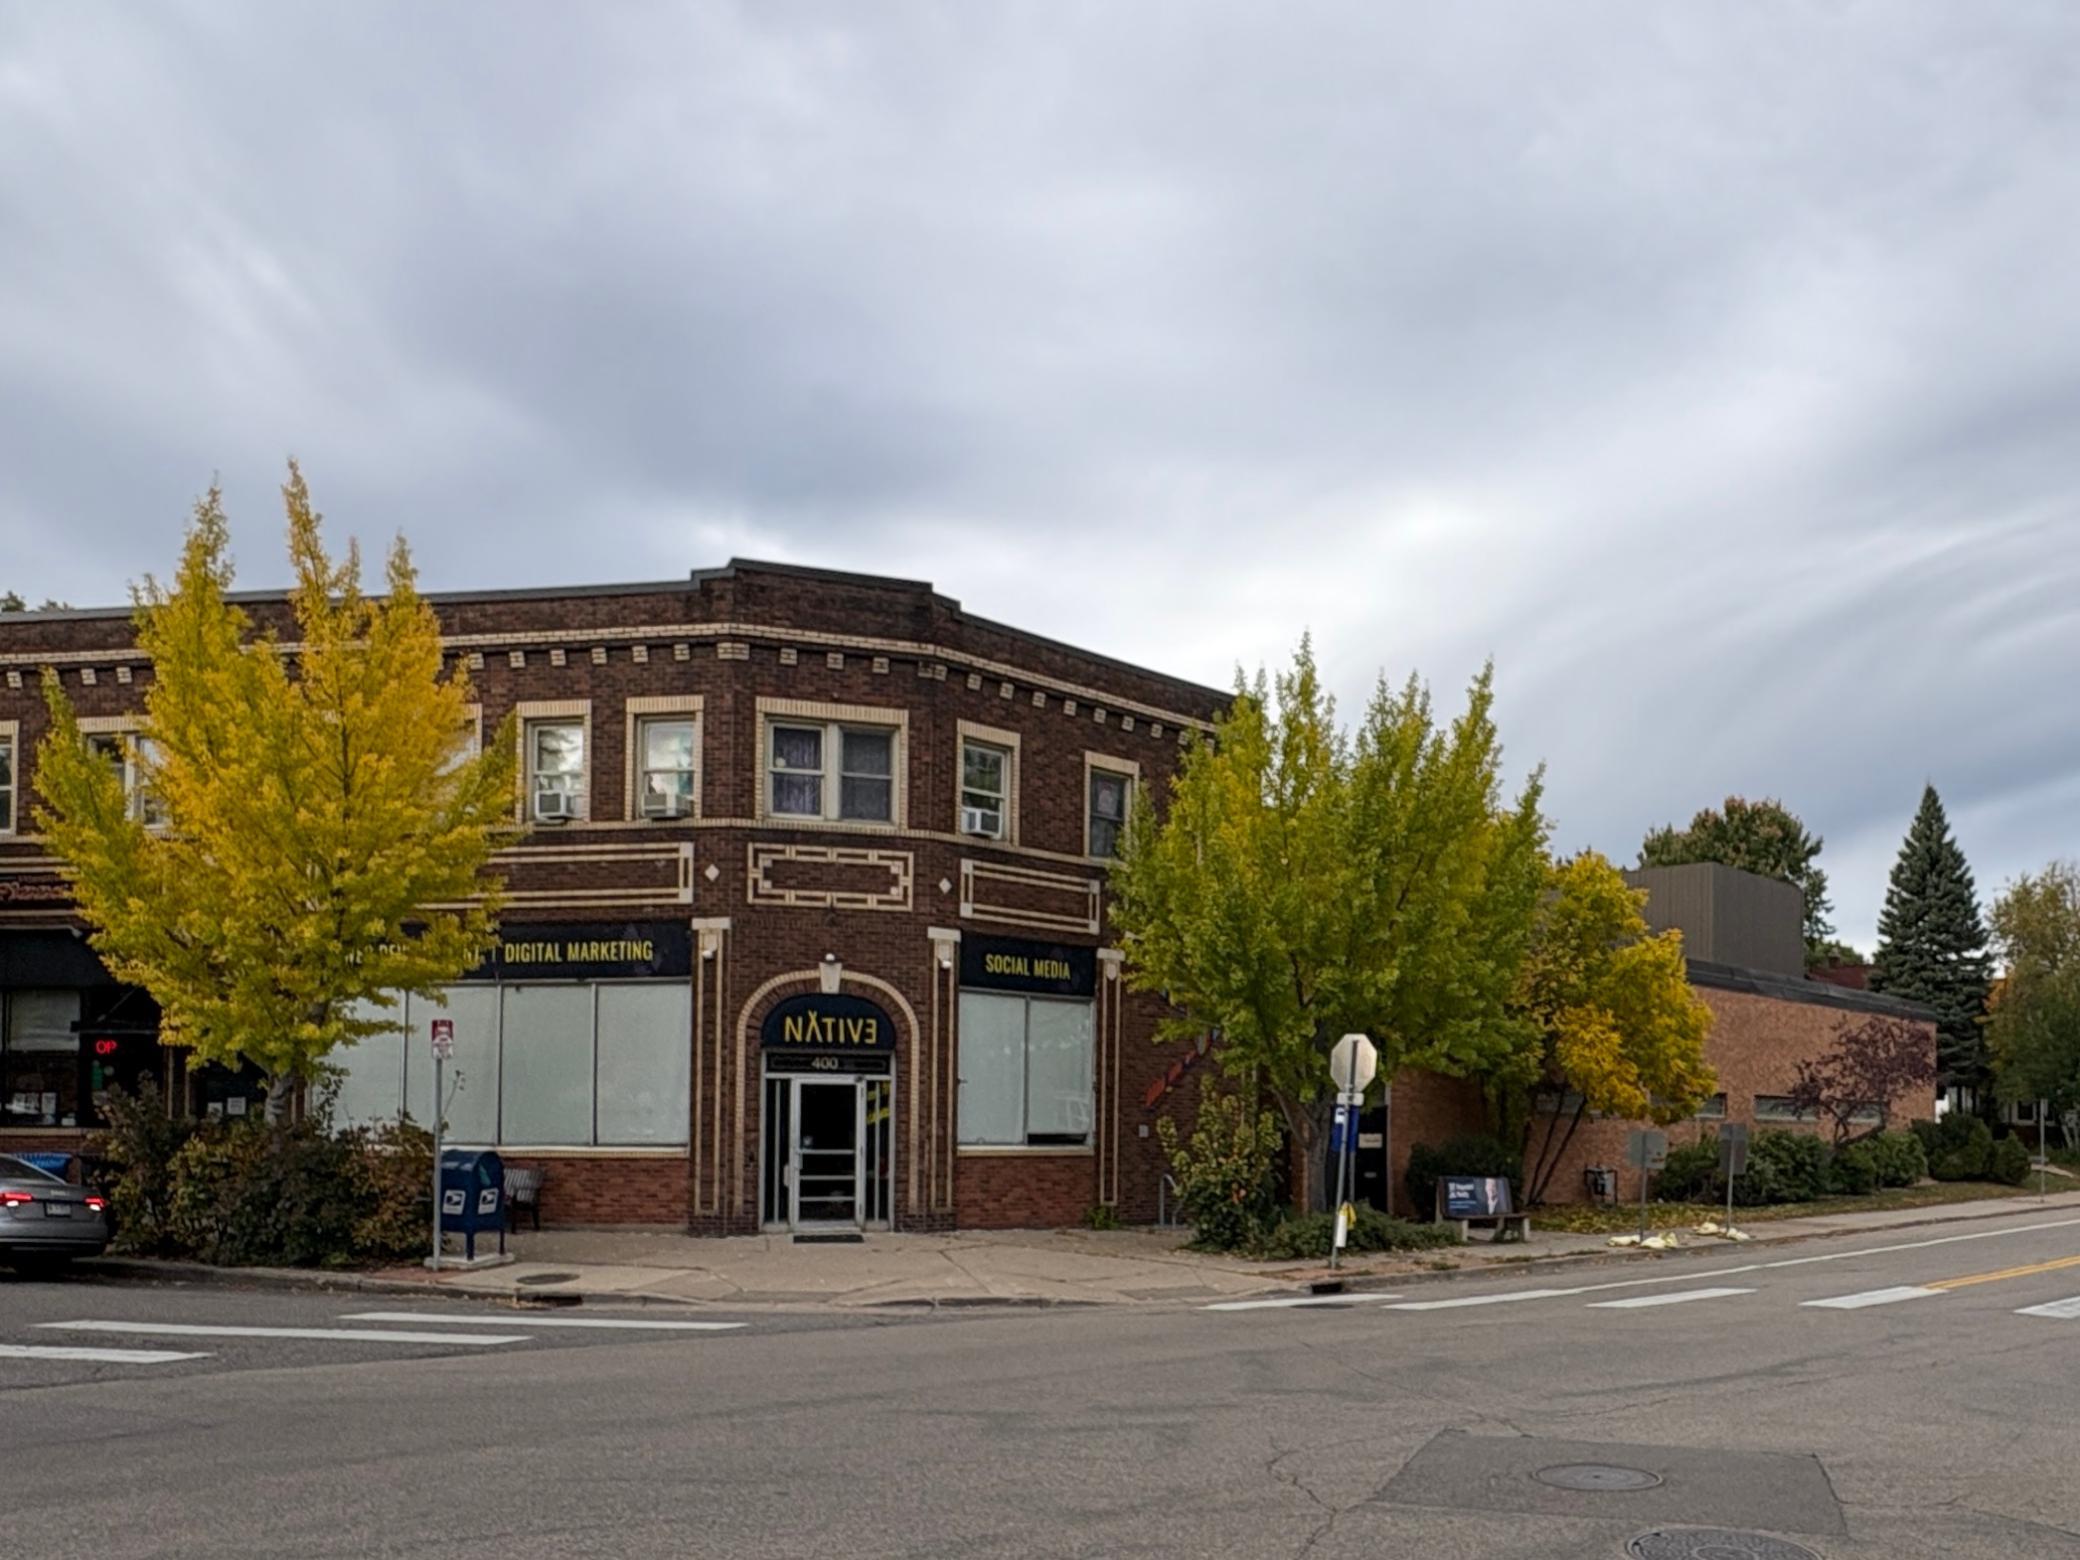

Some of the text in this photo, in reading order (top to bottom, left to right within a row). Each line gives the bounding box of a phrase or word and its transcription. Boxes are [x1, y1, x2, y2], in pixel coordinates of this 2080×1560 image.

[504, 942, 563, 963] DIGITAL
[566, 940, 654, 962] MARKETING
[985, 952, 1071, 980] SOCIAL MEDIA
[784, 1009, 878, 1045] NATIVE
[811, 1056, 839, 1070] 400
